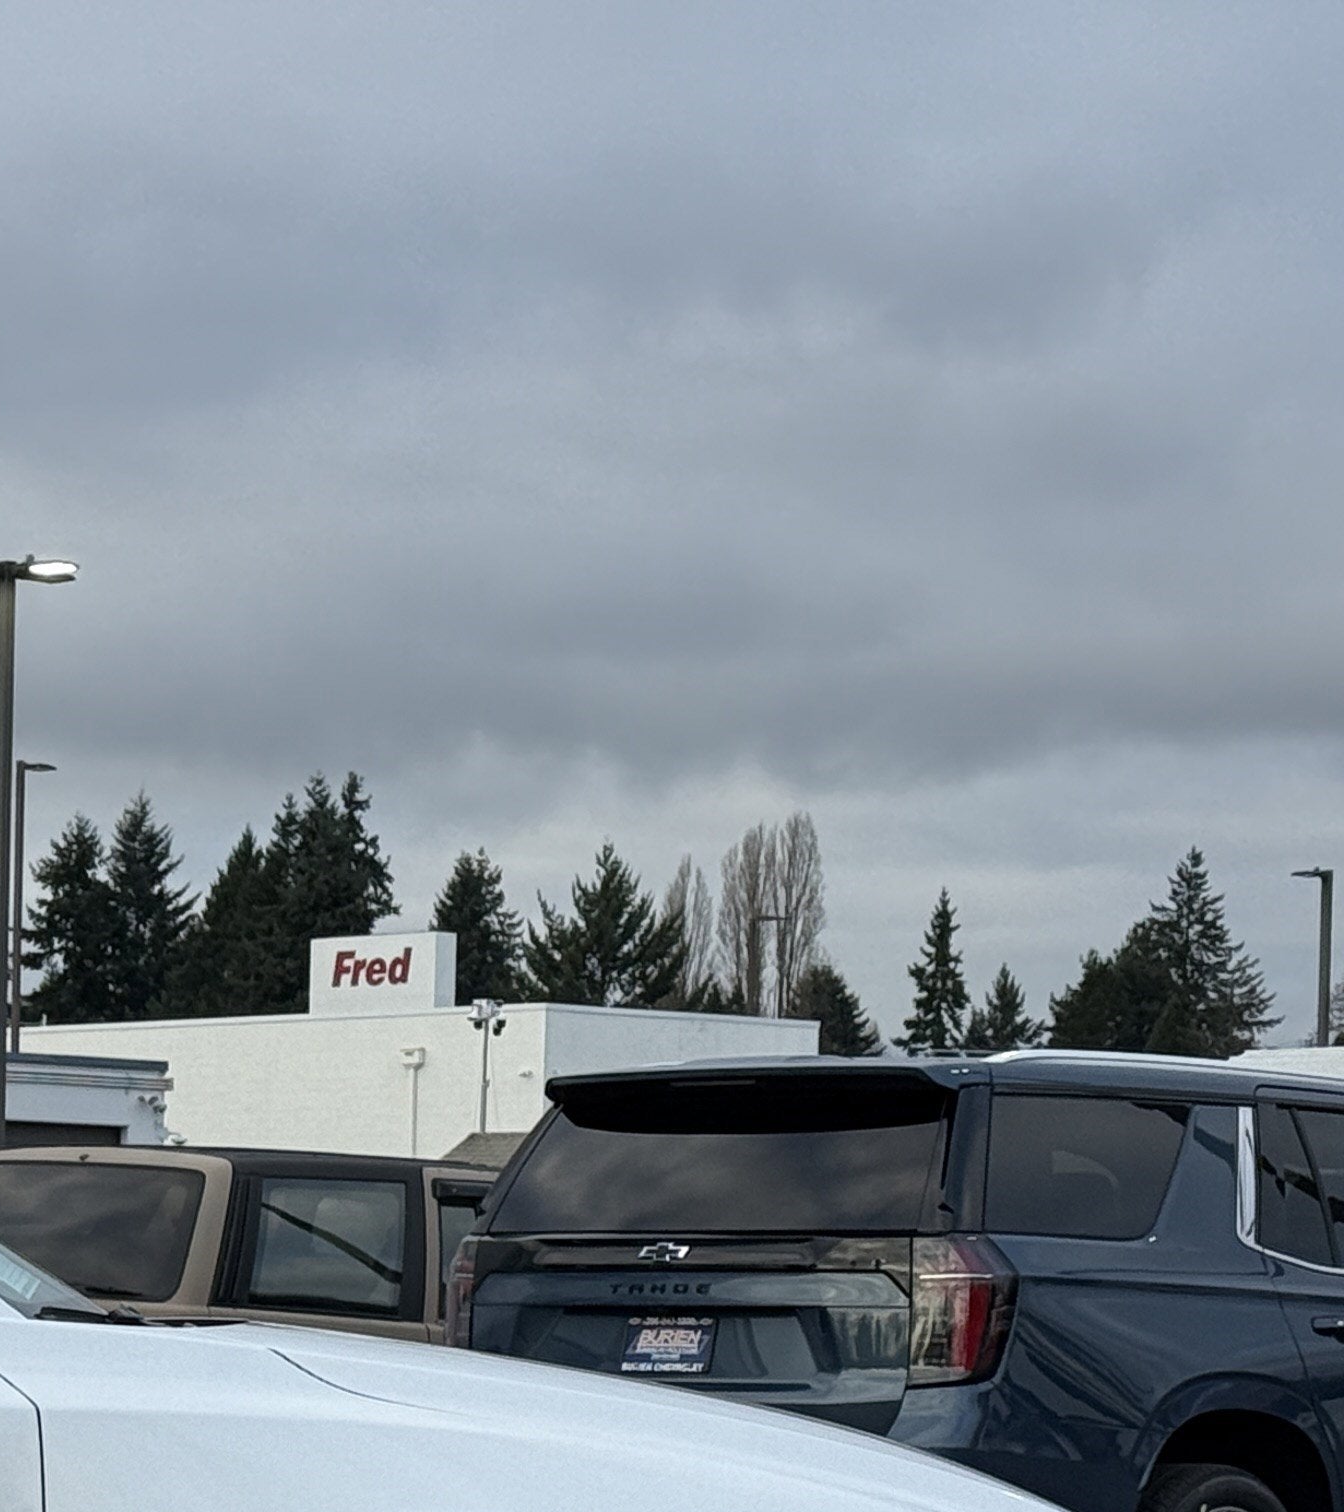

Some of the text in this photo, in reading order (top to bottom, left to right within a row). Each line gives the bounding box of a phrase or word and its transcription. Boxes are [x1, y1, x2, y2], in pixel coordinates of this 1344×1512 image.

[331, 947, 413, 988] Fred
[609, 1282, 712, 1295] TAHOE
[638, 1328, 702, 1347] BURIEN
